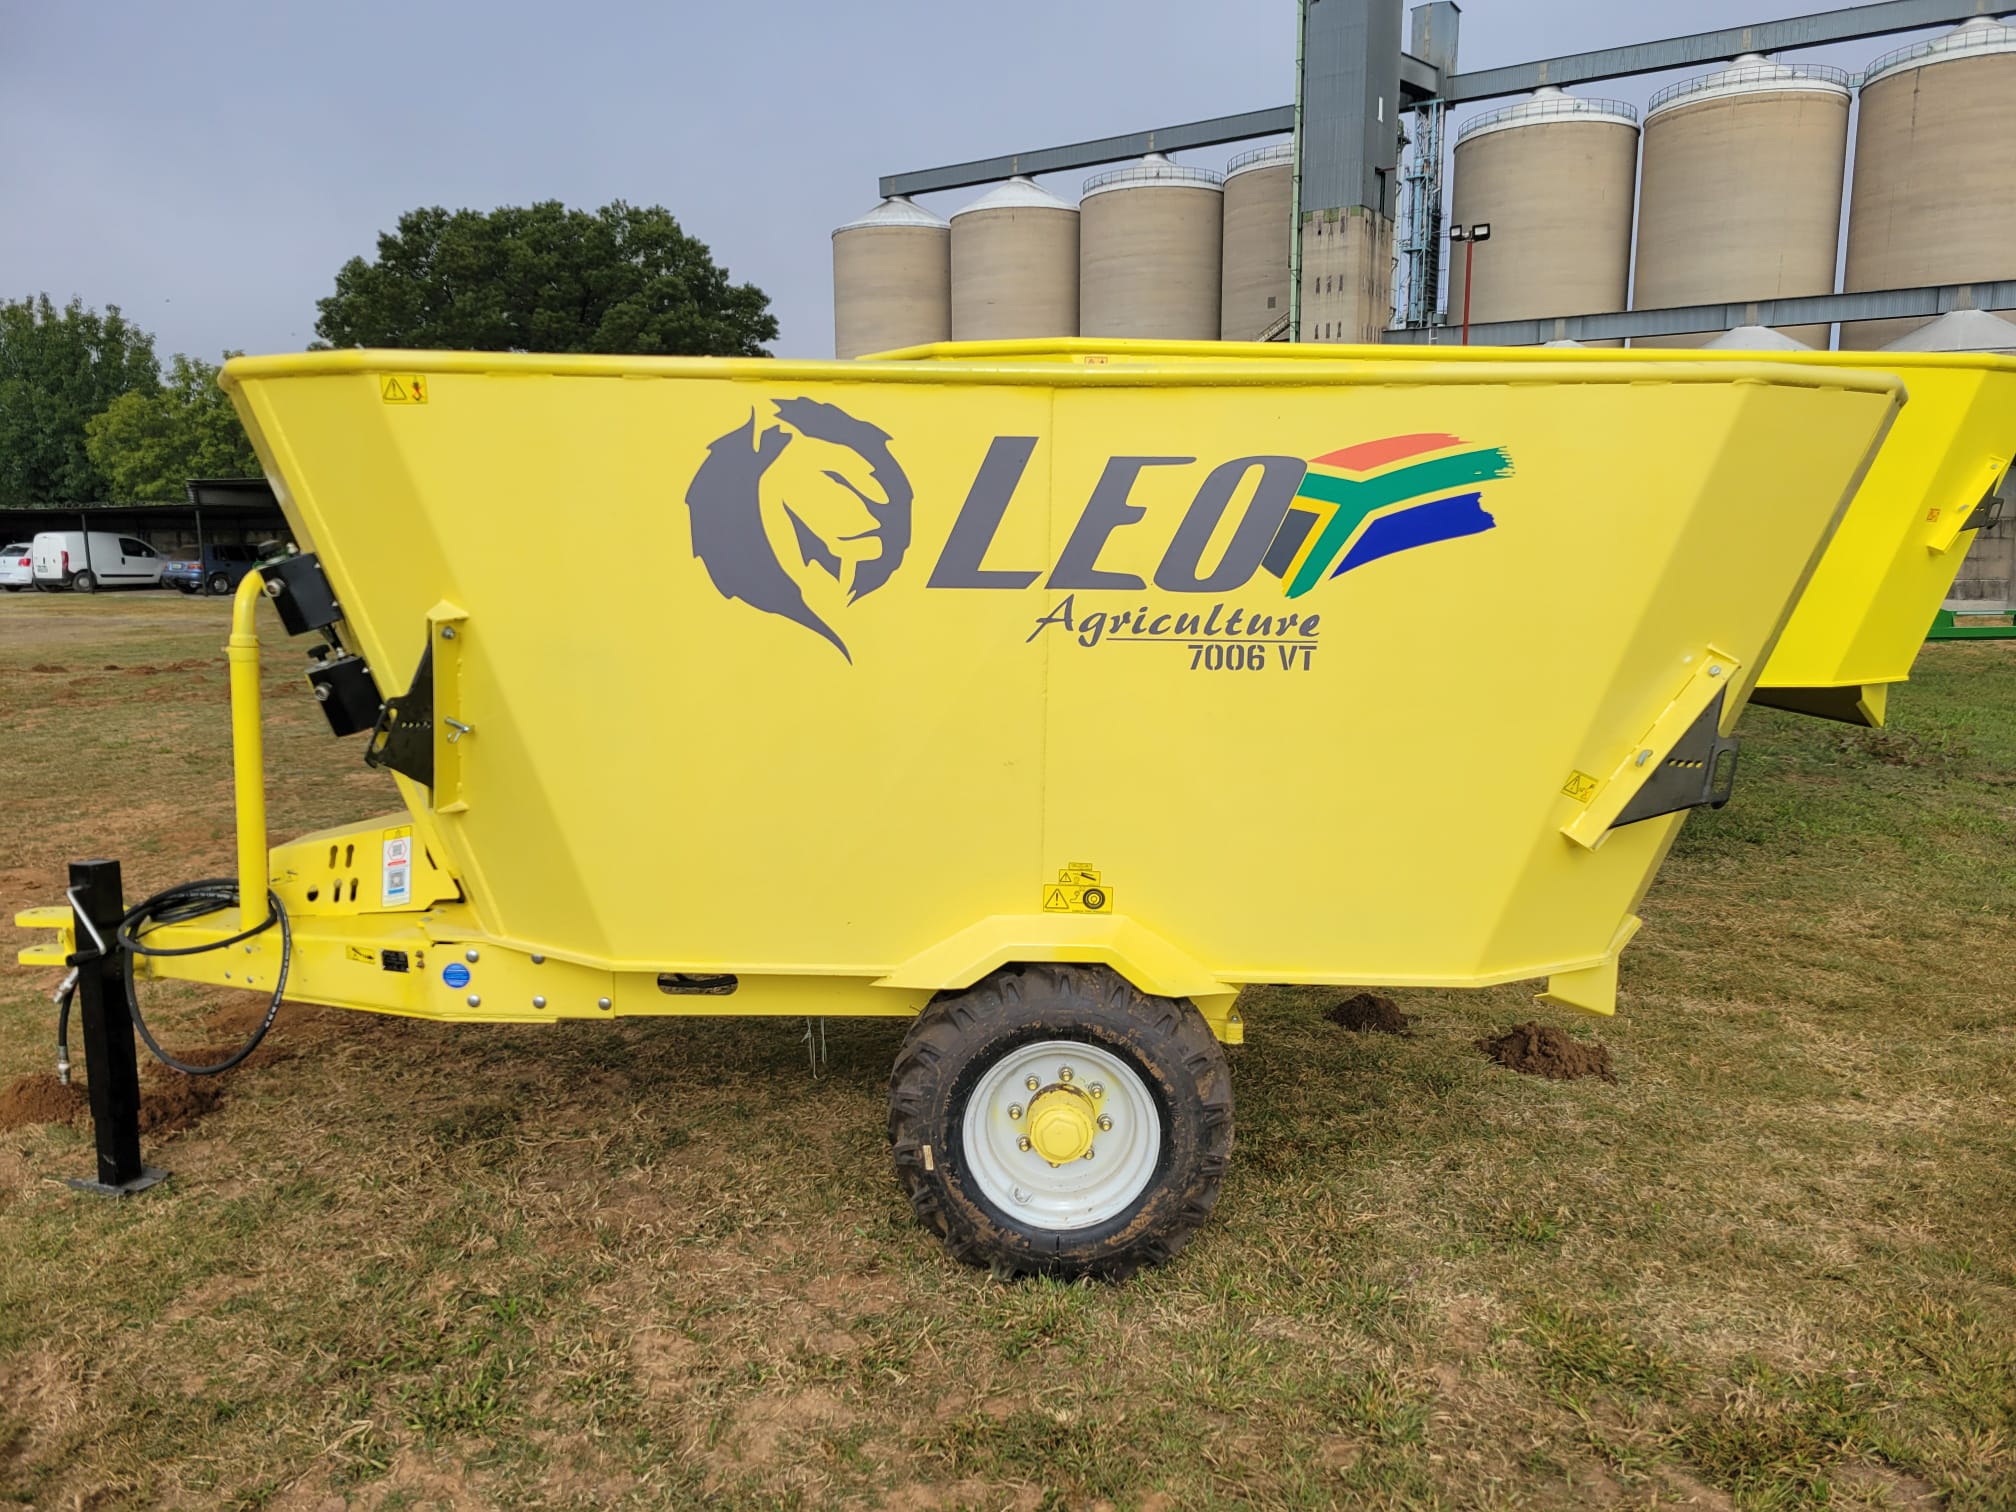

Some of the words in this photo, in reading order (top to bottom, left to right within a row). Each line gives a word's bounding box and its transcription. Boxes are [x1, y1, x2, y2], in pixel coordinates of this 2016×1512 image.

[926, 435, 1308, 593] LEO
[1026, 594, 1320, 648] Agriculture
[1188, 644, 1266, 671] 7006
[1279, 645, 1317, 671] VT
